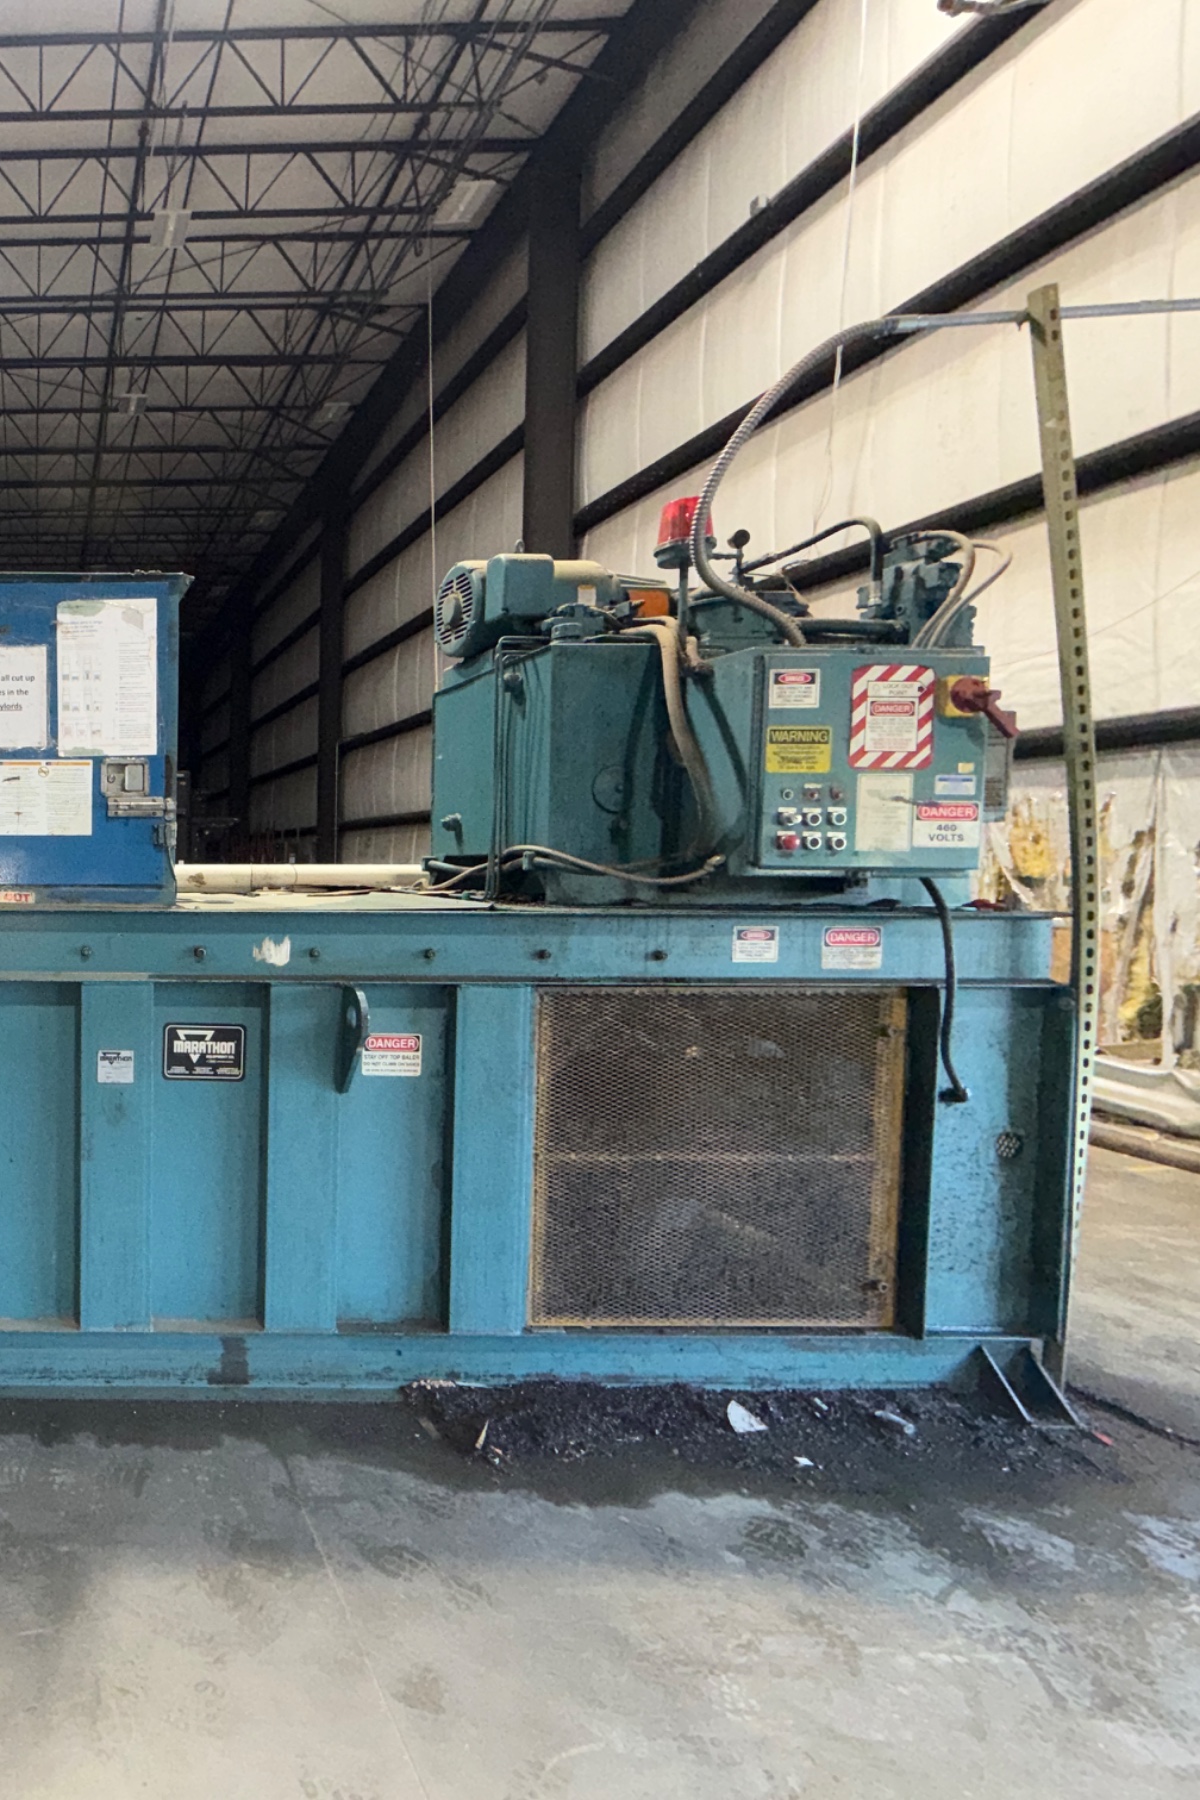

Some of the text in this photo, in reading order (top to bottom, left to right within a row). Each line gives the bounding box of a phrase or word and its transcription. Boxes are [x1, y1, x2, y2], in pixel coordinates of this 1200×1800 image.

[25, 675, 35, 683] up
[16, 688, 29, 696] the
[874, 704, 911, 713] DANGER
[771, 730, 828, 742] WARNING
[921, 806, 974, 817] DANGER
[936, 824, 957, 832] 460
[929, 833, 965, 842] VOLTS
[830, 932, 875, 942] DANGER
[173, 1040, 235, 1054] MARATHON
[368, 1038, 415, 1048] DANGER
